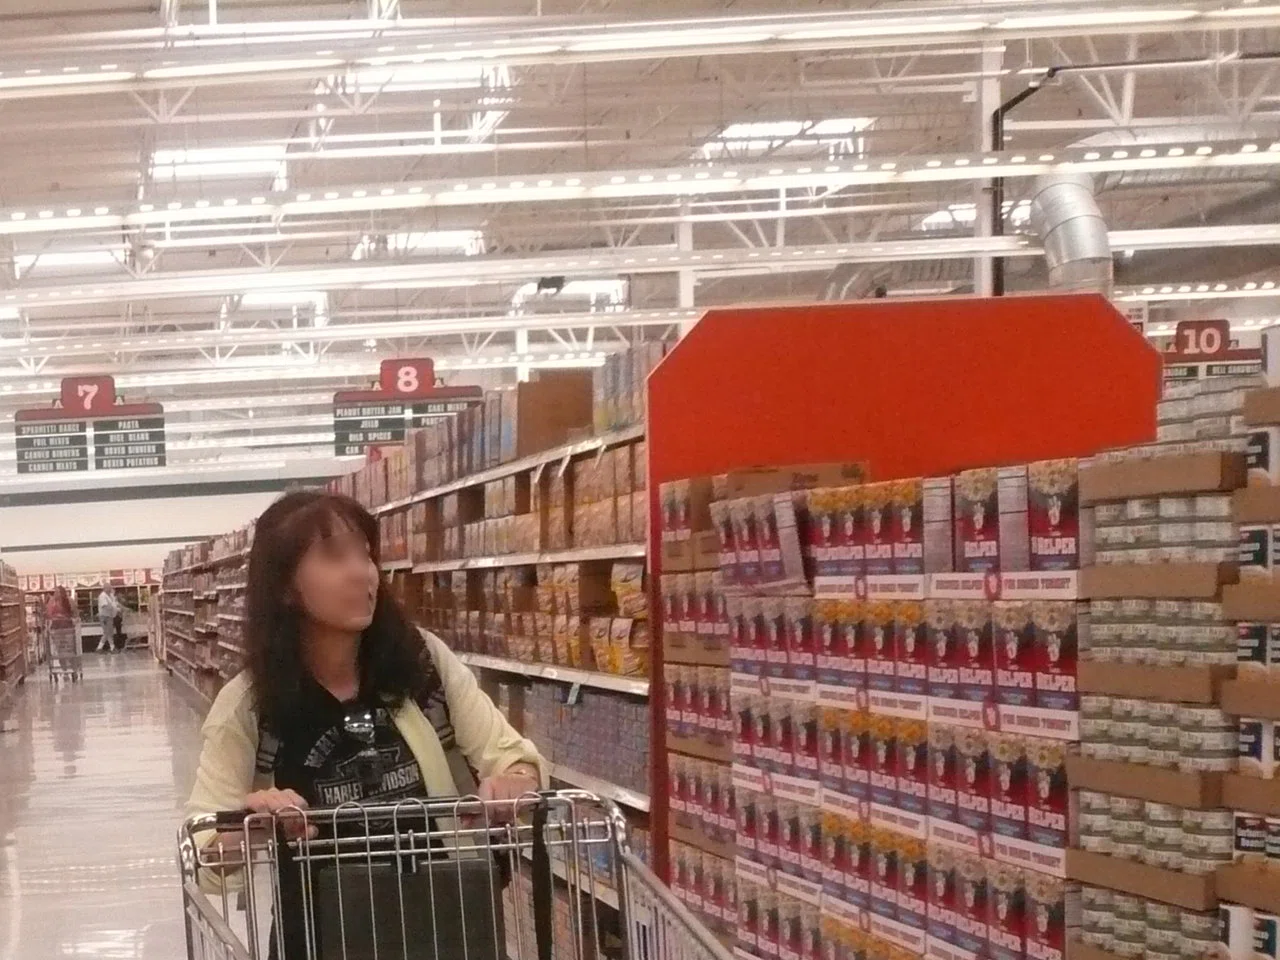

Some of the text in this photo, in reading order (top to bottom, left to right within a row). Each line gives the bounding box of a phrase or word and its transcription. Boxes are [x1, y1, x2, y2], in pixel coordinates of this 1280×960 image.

[1183, 327, 1221, 354] 10
[397, 366, 419, 392] 8
[77, 384, 99, 410] 7
[118, 420, 139, 429] PASTA
